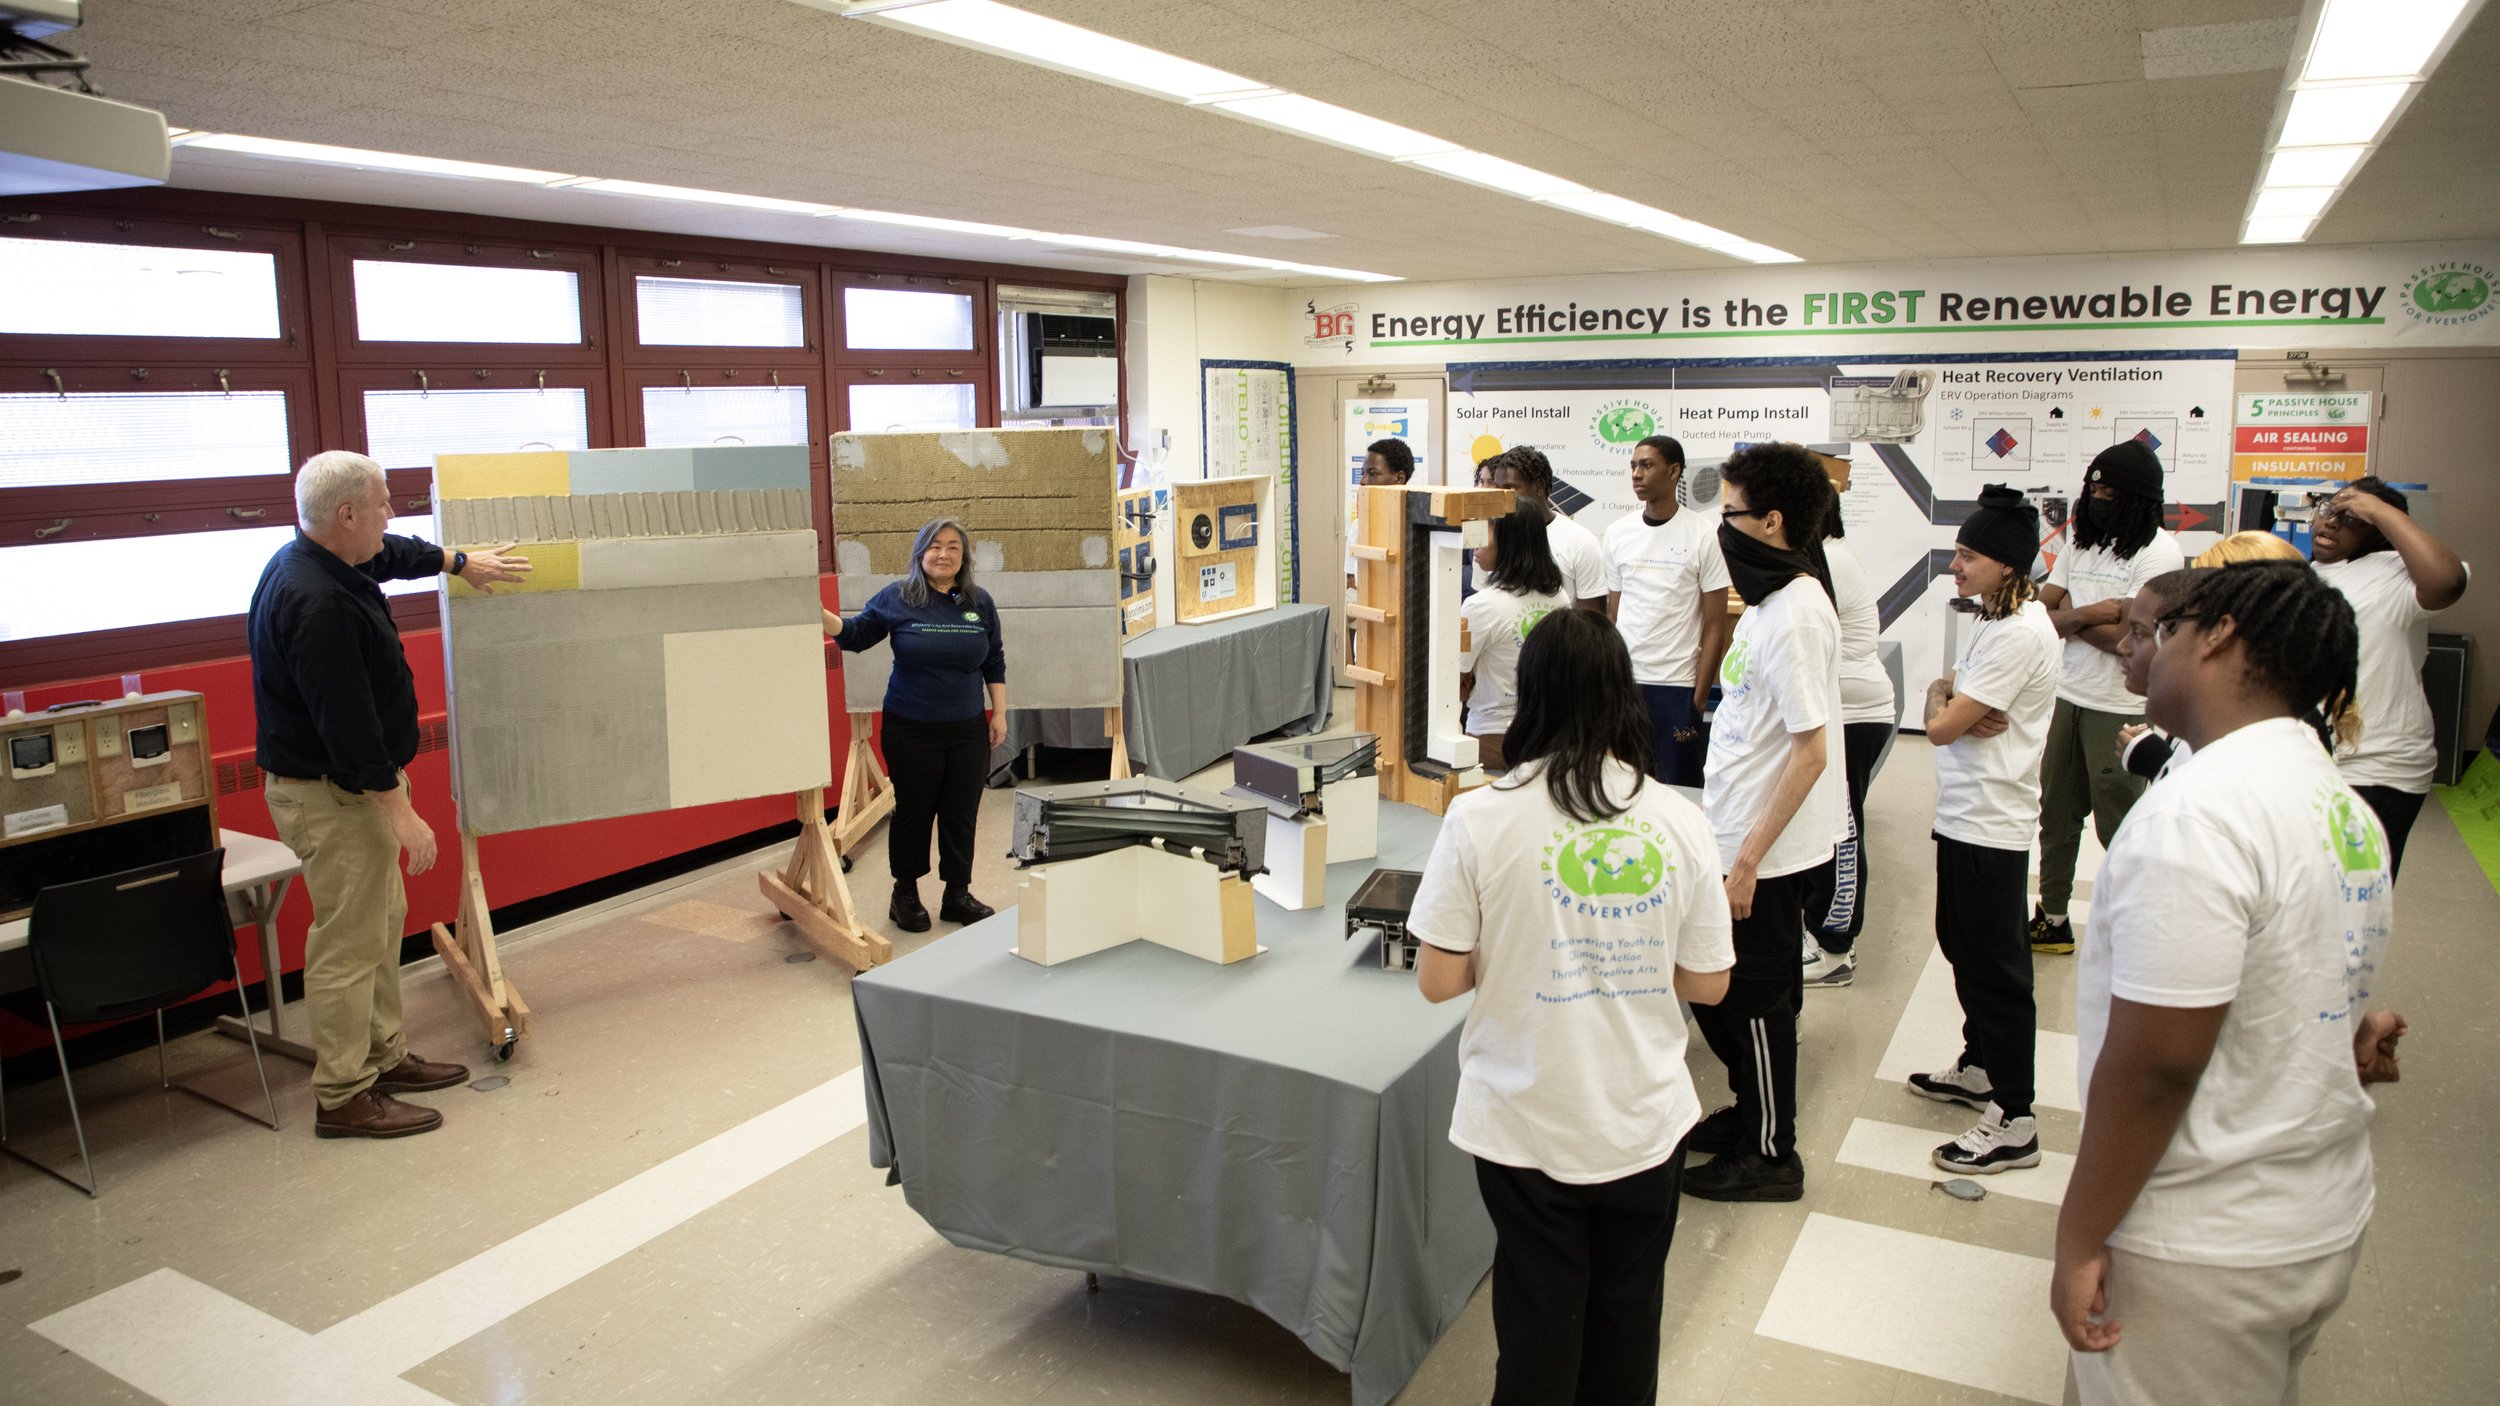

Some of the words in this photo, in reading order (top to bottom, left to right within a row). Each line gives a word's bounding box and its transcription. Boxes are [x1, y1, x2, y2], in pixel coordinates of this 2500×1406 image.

[2400, 262, 2456, 298] PASSIVE
[2462, 262, 2500, 295] HOUSE
[1371, 313, 1486, 340] Energy
[1497, 303, 1669, 334] Efficiency
[1682, 298, 1711, 328] is
[1725, 298, 1789, 327] the
[1803, 290, 1926, 325] FIRST
[1939, 284, 2193, 322] Renewable
[2209, 284, 2387, 319] Energy
[2401, 302, 2422, 320] FOR
[1313, 312, 1354, 338] BG
[1943, 370, 1981, 384] Heat
[1986, 369, 2063, 385] Recovery
[2067, 367, 2163, 382] Ventilation
[1941, 391, 1962, 400] ERV
[1964, 390, 2019, 402] Operation
[2022, 389, 2074, 401] Diagrams
[1237, 368, 1249, 442] NTELLO
[1457, 407, 1489, 419] Solar
[1492, 407, 1527, 419] Panel
[1531, 406, 1570, 419] Install
[2250, 399, 2264, 417] 5
[2268, 398, 2315, 407] PASSIVE
[2318, 397, 2359, 406] HOUSE
[1590, 399, 1629, 430] PASSIVE
[1633, 400, 1664, 429] HOUSE
[1679, 407, 1713, 419] Heat
[1717, 407, 1760, 422] Pump
[1764, 406, 1809, 419] Install
[1590, 434, 1606, 450] FOR
[1682, 430, 1716, 439] Ducted
[1718, 430, 1741, 439] Heat
[1743, 430, 1772, 440] Pump
[2252, 432, 2279, 444] AIR
[2282, 431, 2349, 444] SEALING
[1239, 451, 1248, 476] PLU
[1562, 468, 1604, 476] Photovoltaic
[1605, 468, 1625, 476] Panel
[2252, 461, 2346, 473] INSULATION
[1608, 502, 1634, 513] Charge
[1541, 815, 1615, 871] PASSVE
[1544, 878, 1572, 908] FOR
[1822, 841, 1858, 932] RELIGION
[1551, 938, 1613, 951] Emowering
[1617, 937, 1645, 948] Youth
[1649, 937, 1665, 947] for
[1610, 952, 1642, 962] Action
[1551, 964, 1588, 980] Through
[1592, 965, 1634, 978] Creative
[1637, 964, 1658, 974] Arts
